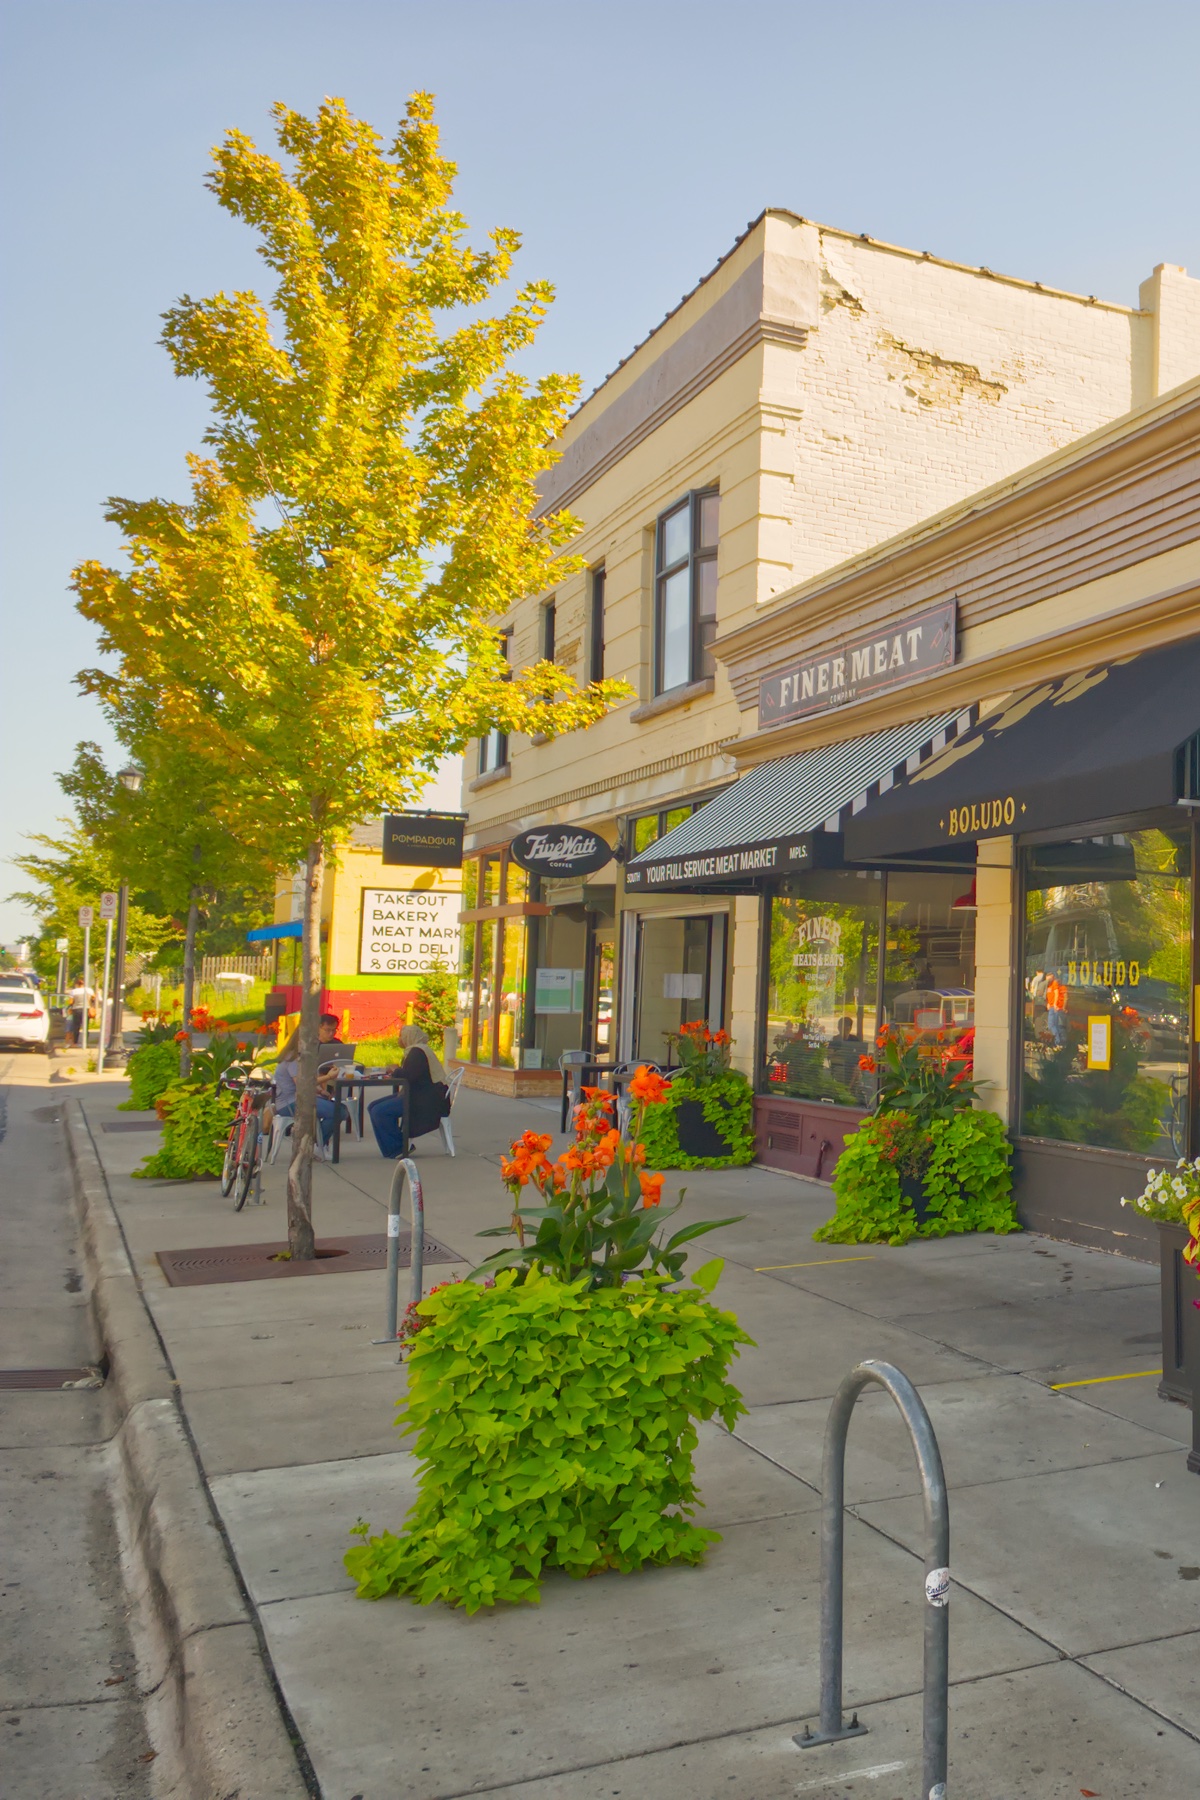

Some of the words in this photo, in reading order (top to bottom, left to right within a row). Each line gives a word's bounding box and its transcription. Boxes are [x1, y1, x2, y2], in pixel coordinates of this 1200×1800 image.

[779, 656, 846, 708] FINER
[851, 625, 923, 683] MEAT
[829, 688, 857, 705] COMPANY
[948, 796, 1016, 837] BOLUDO
[391, 833, 456, 847] POMPADOUR
[549, 861, 573, 869] COFFEE
[626, 871, 641, 884] SOUTH
[646, 865, 666, 884] YOUR
[666, 862, 683, 880] FULL
[683, 857, 716, 879] SERVICE
[715, 853, 740, 875] MEAT
[739, 846, 778, 871] MARKET
[372, 909, 439, 922] BAKERY
[371, 925, 415, 938] MEAT
[797, 916, 842, 948] FINER
[370, 942, 412, 954] COLD
[419, 943, 454, 955] DELI
[386, 959, 461, 971] GROCRY
[1067, 960, 1140, 987] BOLUDO
